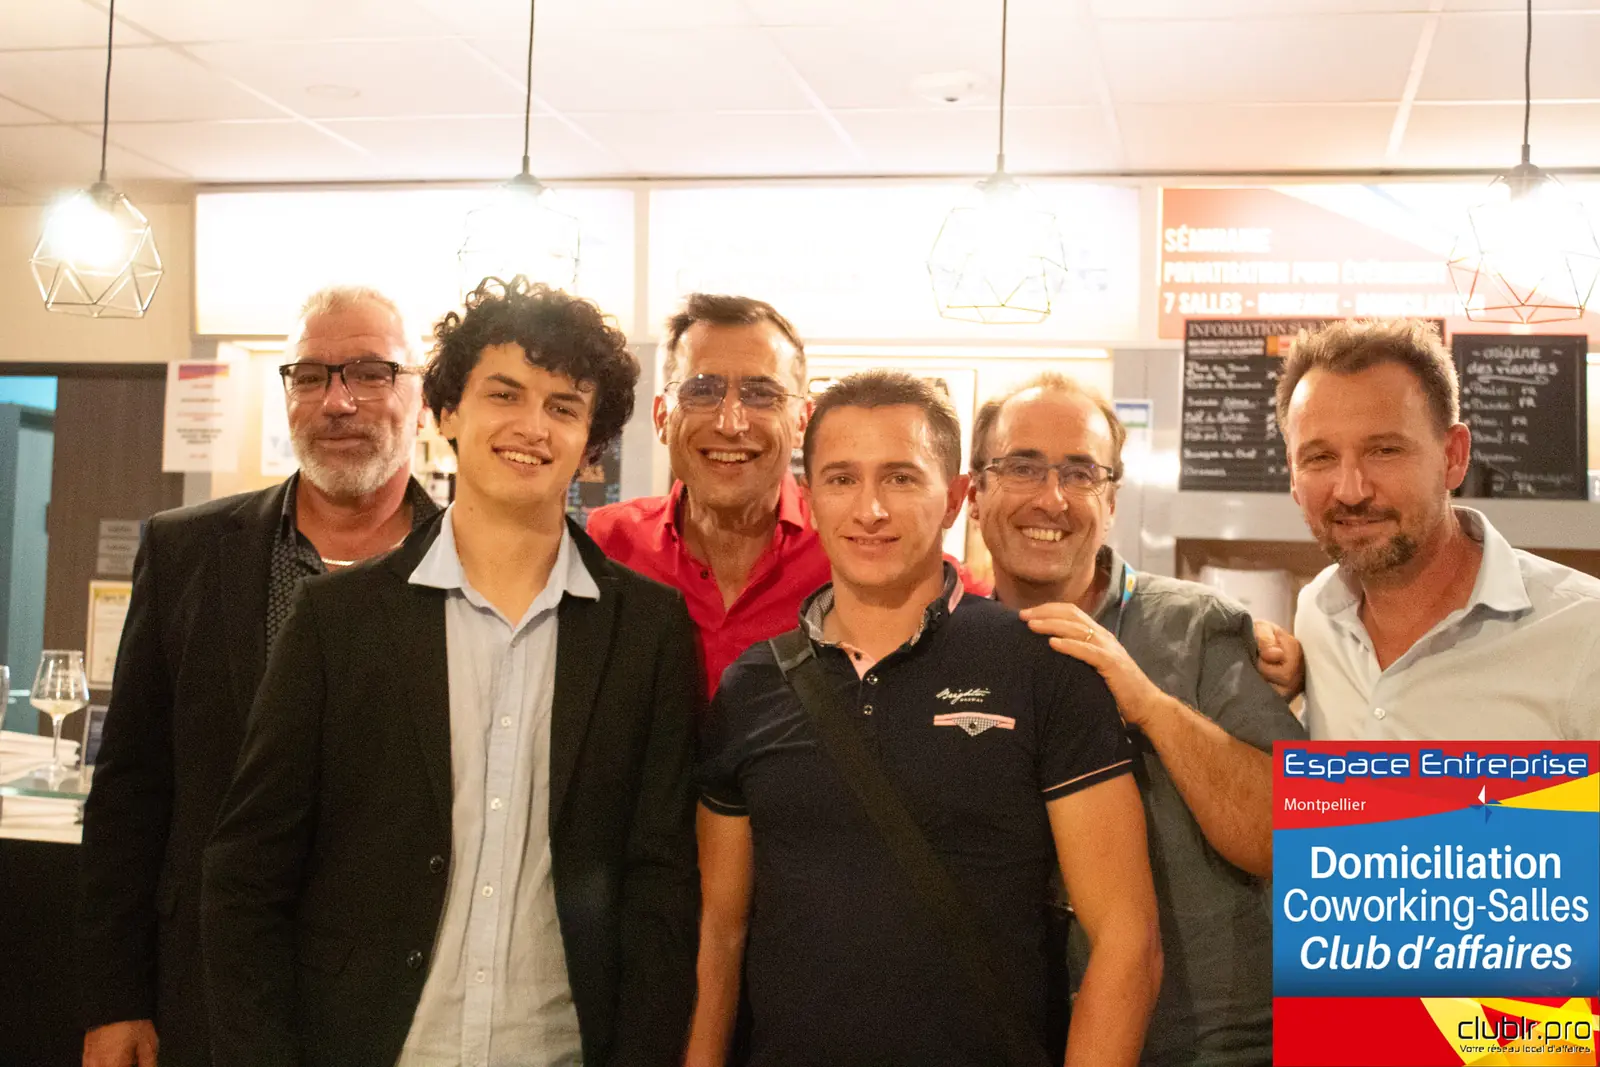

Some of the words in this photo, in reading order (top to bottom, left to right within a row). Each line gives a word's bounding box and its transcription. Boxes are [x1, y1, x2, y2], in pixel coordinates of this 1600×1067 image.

[1163, 292, 1176, 315] 7
[1179, 292, 1242, 315] SALLES
[1188, 322, 1287, 337] INFORMATION
[1467, 361, 1493, 375] des
